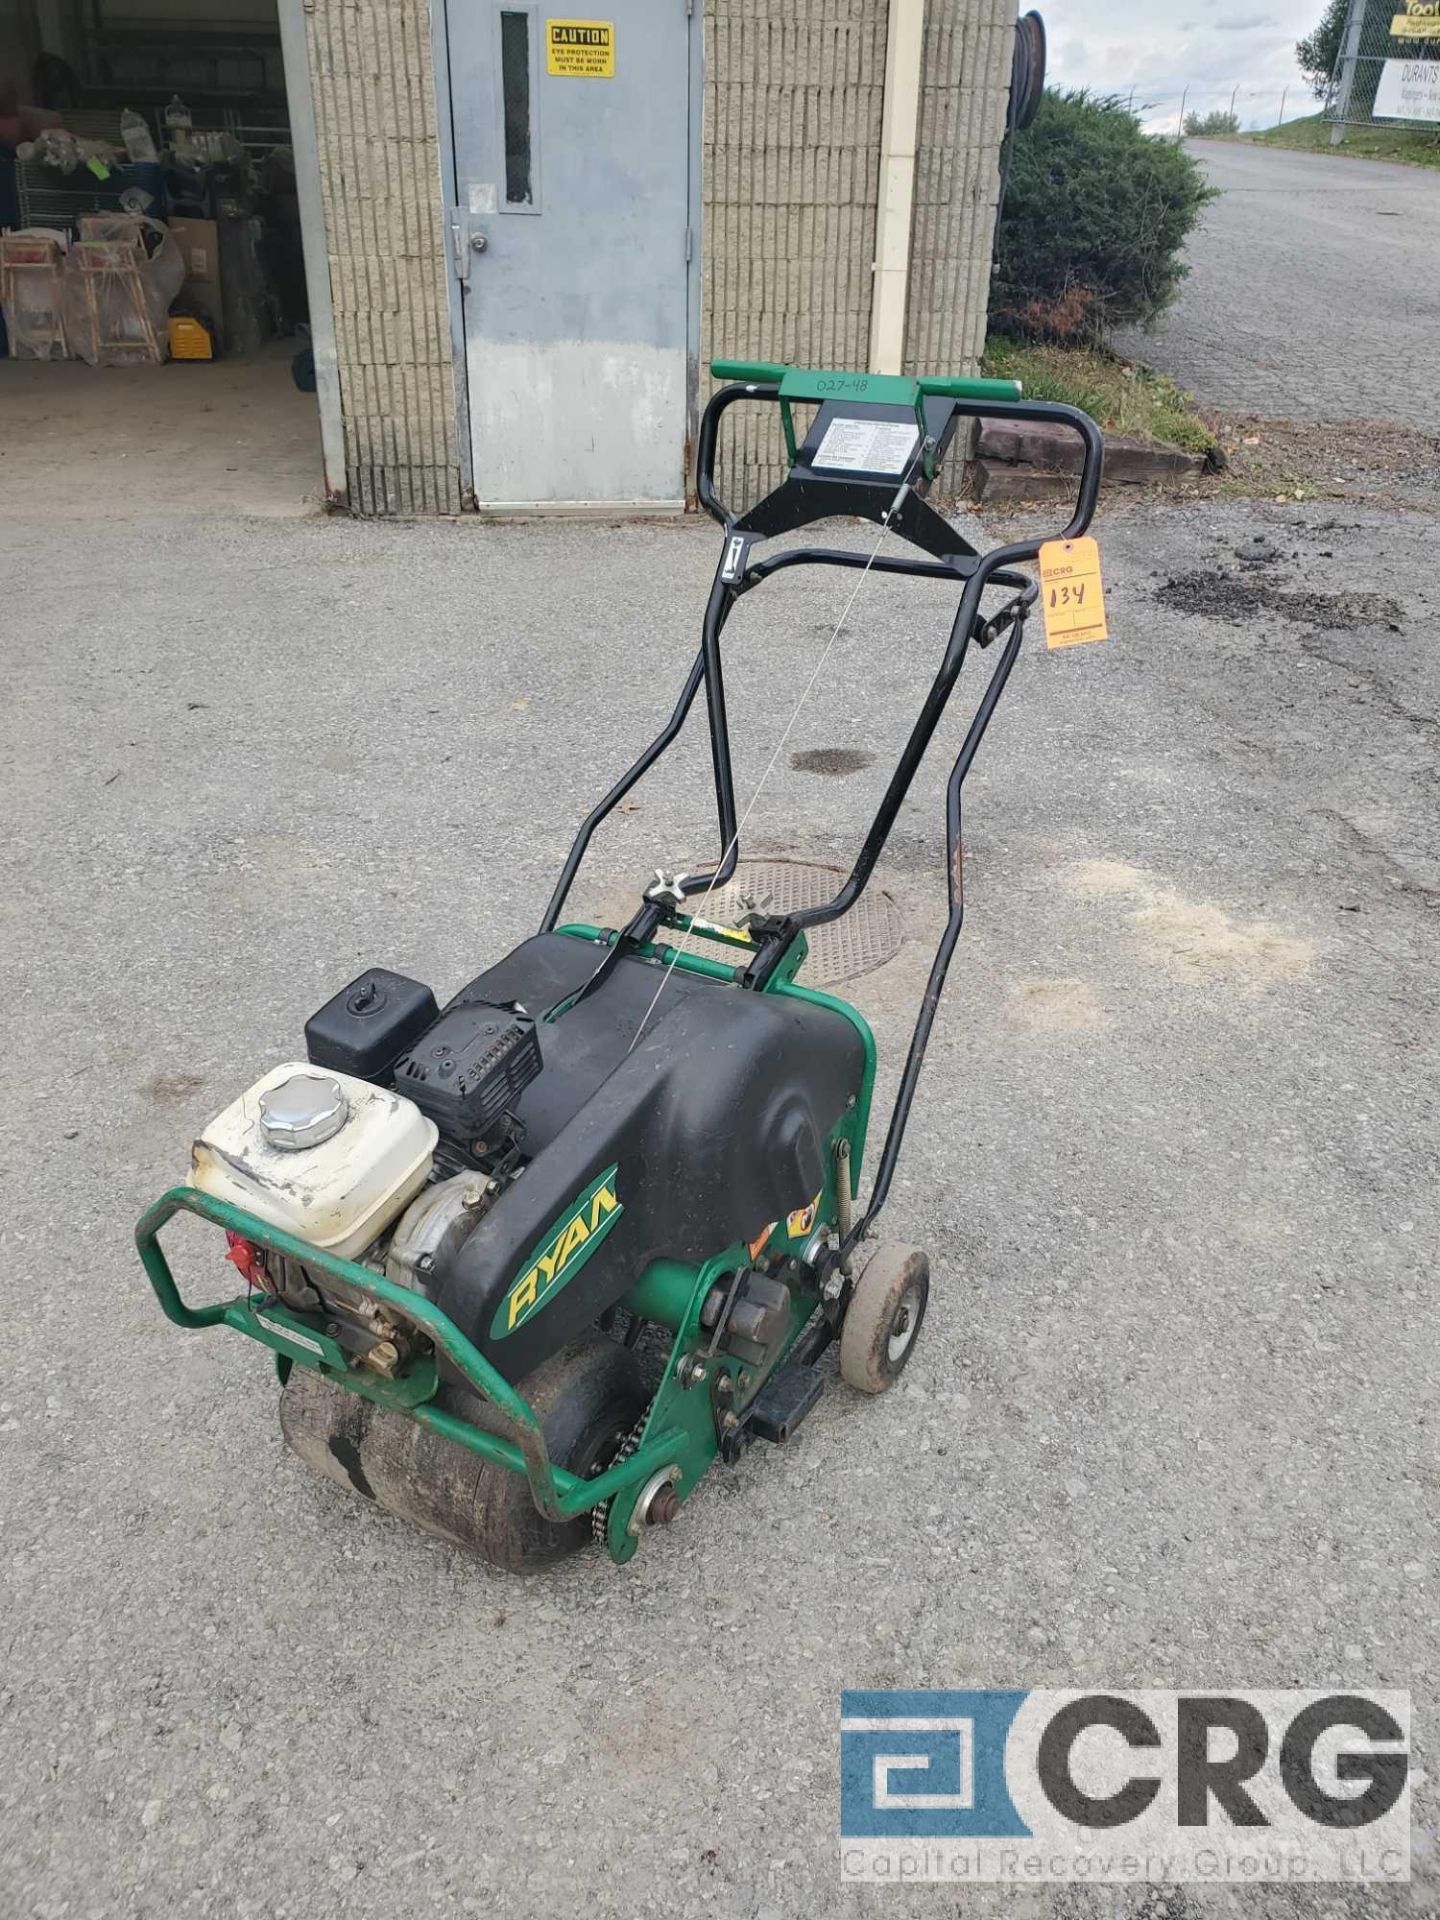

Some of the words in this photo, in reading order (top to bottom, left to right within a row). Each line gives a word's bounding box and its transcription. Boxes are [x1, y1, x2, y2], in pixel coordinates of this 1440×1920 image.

[552, 27, 609, 44] CAUTION
[567, 49, 610, 57] PROTECTION
[816, 379, 868, 392] 027-48
[1050, 583, 1085, 608] 134
[508, 1186, 618, 1331] RYAN
